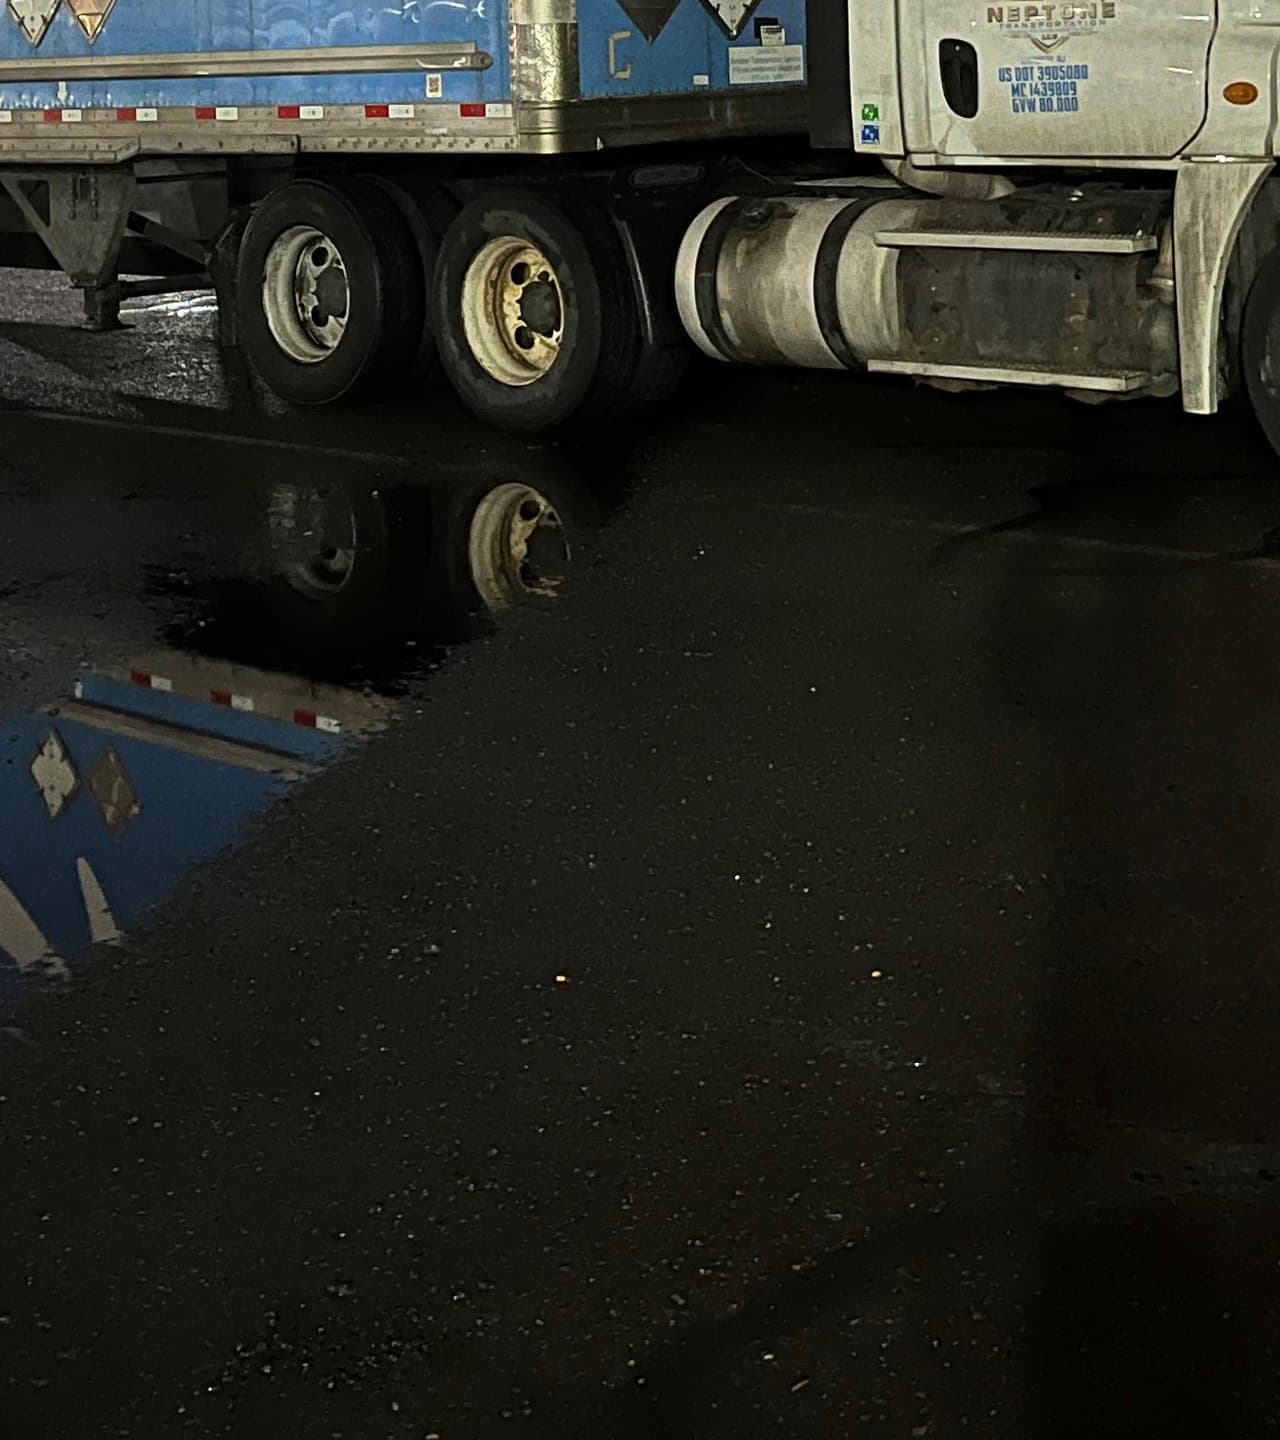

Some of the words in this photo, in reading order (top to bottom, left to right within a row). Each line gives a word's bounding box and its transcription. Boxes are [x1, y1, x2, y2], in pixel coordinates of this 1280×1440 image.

[998, 67, 1012, 82] US
[1014, 66, 1034, 81] DOT
[1011, 83, 1026, 97] MC
[1012, 98, 1036, 113] GVW
